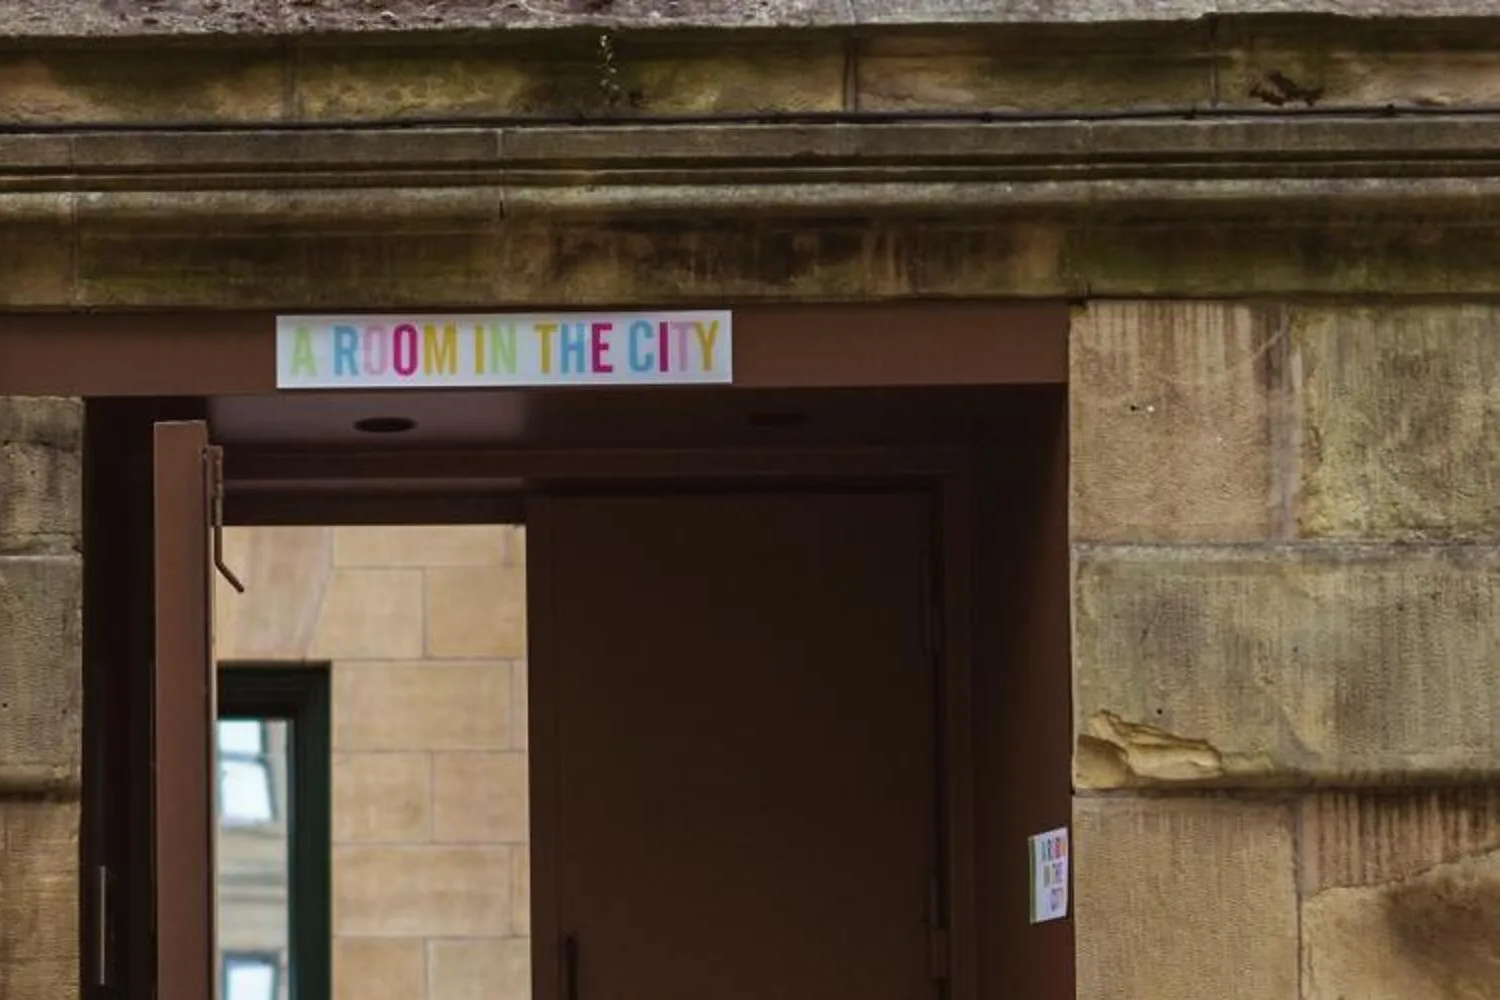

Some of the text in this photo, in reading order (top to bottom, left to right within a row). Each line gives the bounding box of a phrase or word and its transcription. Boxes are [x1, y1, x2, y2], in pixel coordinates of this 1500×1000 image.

[290, 319, 719, 376] A ROOM IN THE CITY
